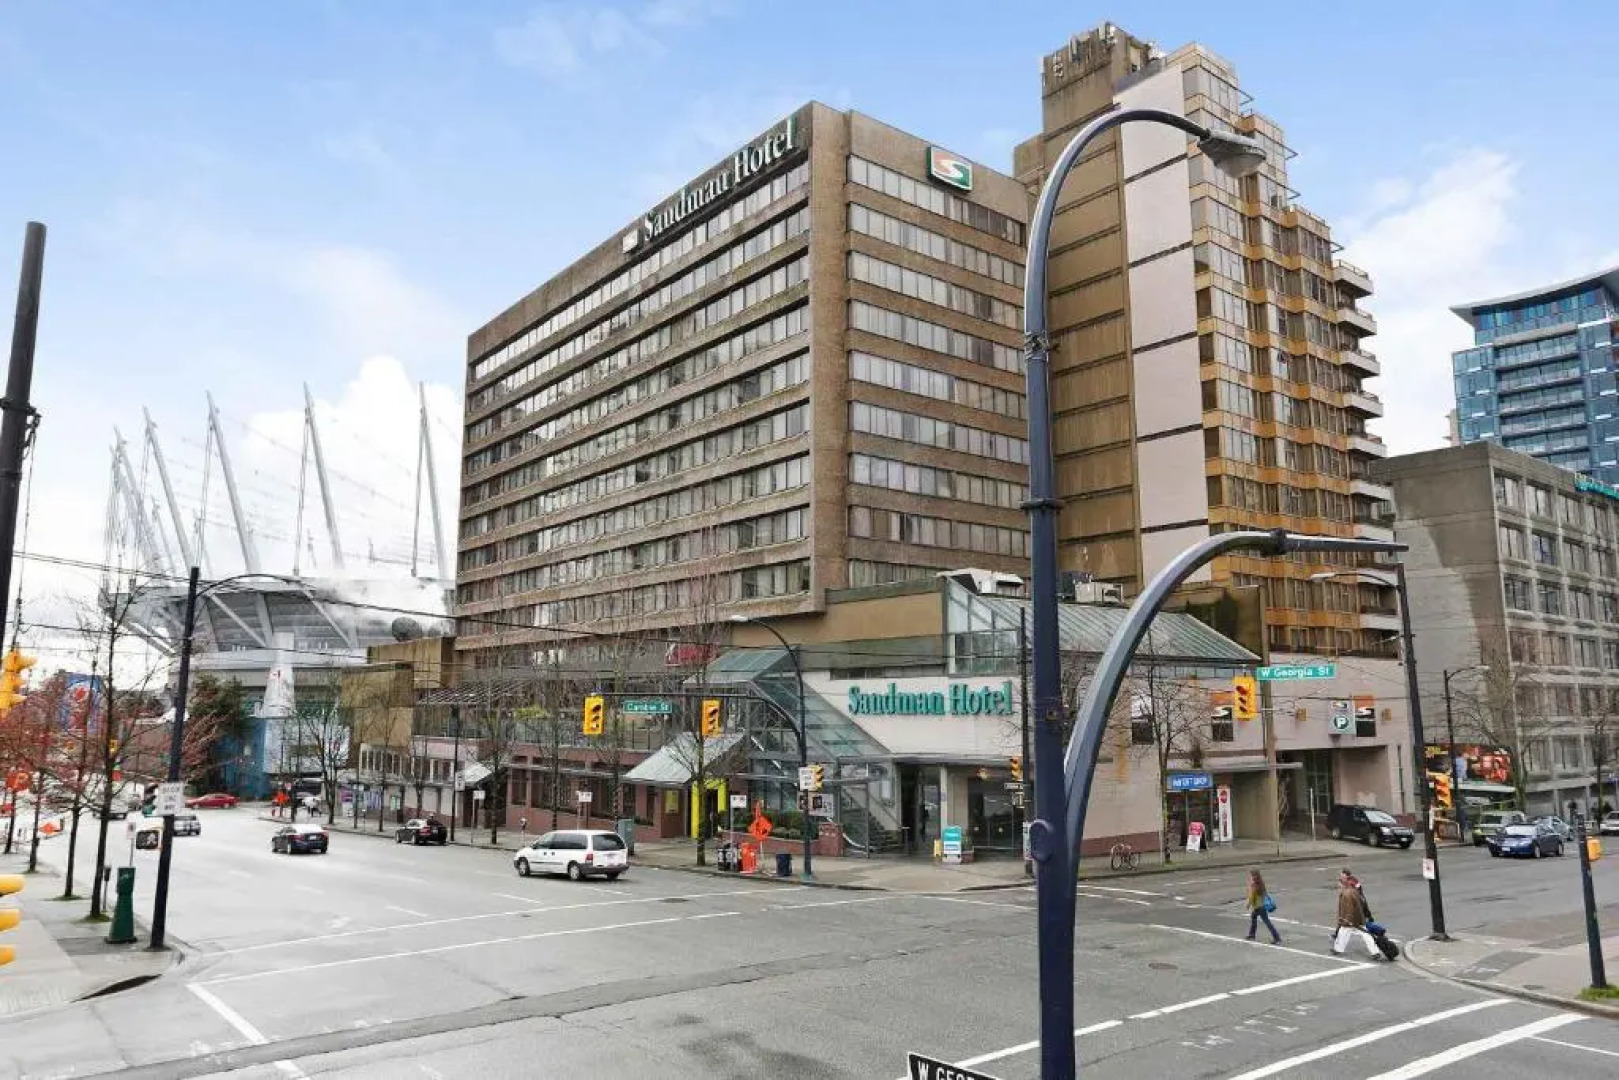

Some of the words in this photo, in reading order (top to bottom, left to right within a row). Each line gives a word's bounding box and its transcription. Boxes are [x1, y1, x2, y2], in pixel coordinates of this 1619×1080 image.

[645, 168, 732, 241] Sandman
[735, 116, 797, 183] Hotel
[1261, 667, 1270, 678] W
[1274, 666, 1313, 679] Georgia
[1318, 666, 1329, 676] St
[849, 682, 945, 716] Sandman
[949, 680, 1017, 716] Hotel
[1337, 717, 1346, 728] P
